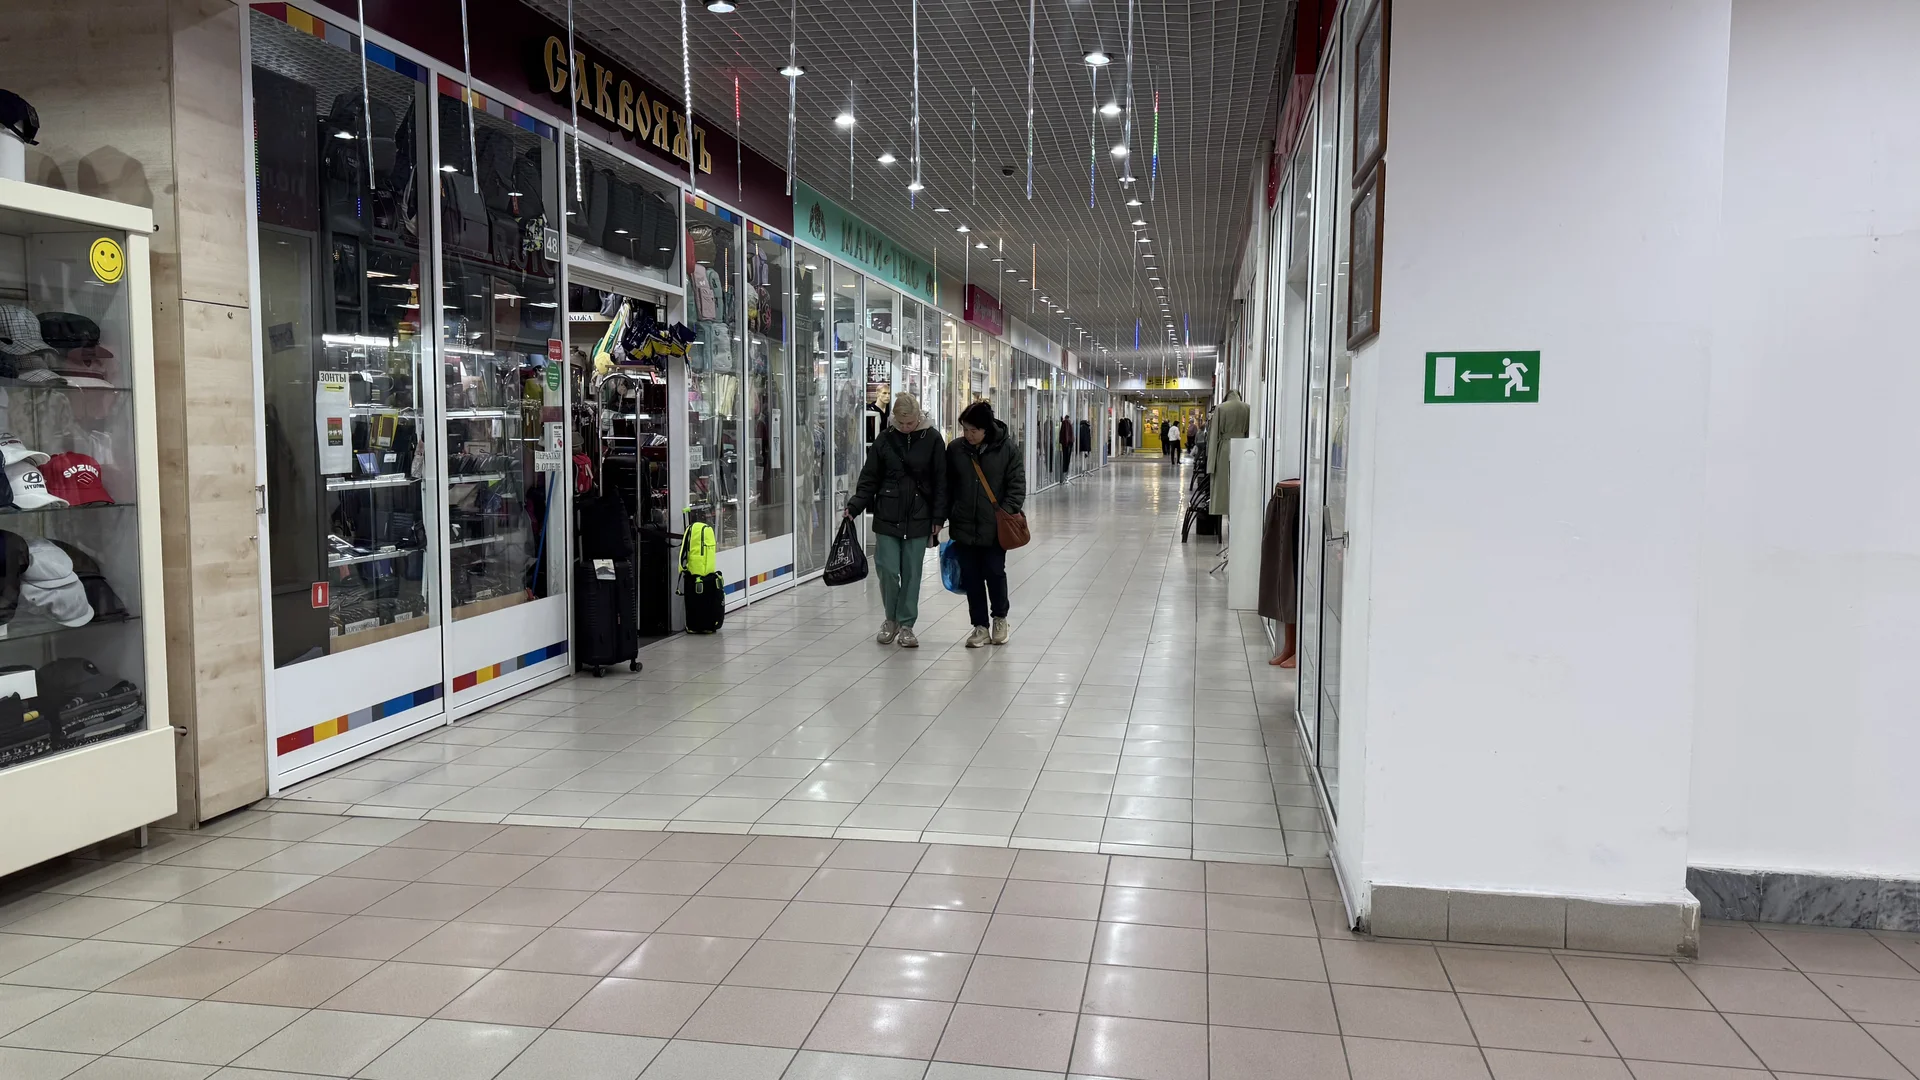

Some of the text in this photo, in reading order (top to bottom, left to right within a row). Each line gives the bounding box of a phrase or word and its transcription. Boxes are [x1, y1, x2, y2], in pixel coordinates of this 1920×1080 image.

[543, 35, 712, 175] САКВОЯЖЪ
[547, 236, 558, 254] 48
[320, 372, 347, 383] ЗОНТЫ
[63, 464, 99, 478] SUZUKI
